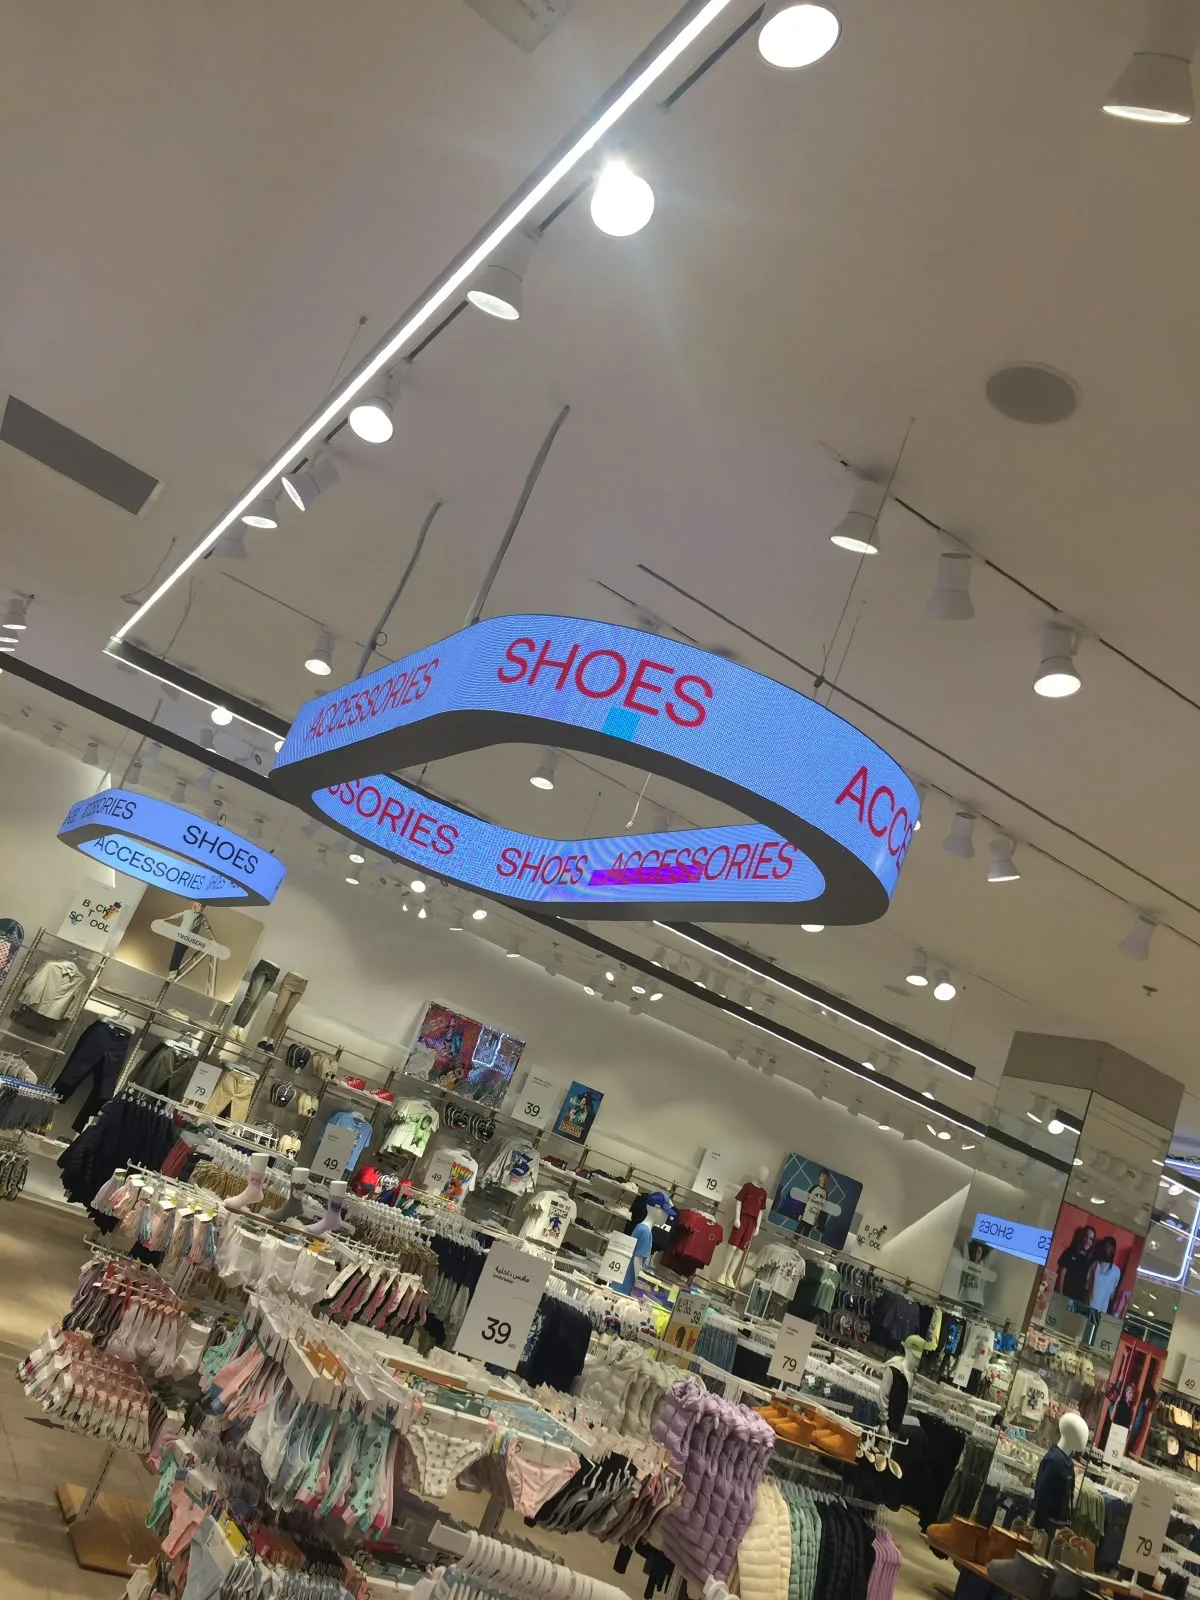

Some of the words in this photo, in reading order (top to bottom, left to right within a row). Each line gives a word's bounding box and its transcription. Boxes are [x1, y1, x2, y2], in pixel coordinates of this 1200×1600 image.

[305, 658, 440, 740] ACCESSORIES
[497, 637, 714, 728] SHOES
[183, 825, 258, 874] SHOES
[93, 837, 204, 890] ACCESSORIES
[496, 847, 588, 886] SHOES
[600, 841, 799, 885] ACCESSORIES
[69, 910, 110, 932] SCOOL
[176, 932, 206, 948] TROUSERS
[195, 1085, 206, 1096] 79
[524, 1102, 541, 1117] 39
[323, 1157, 339, 1171] 49
[431, 1172, 442, 1181] 49
[706, 1178, 718, 1190] 19
[856, 1235, 880, 1250] SCOOL
[608, 1261, 621, 1272] 49
[481, 1316, 512, 1345] 39
[782, 1355, 798, 1372] 79
[1184, 1378, 1196, 1390] 49
[420, 1413, 432, 1427] 5
[514, 1441, 524, 1454] 5
[1136, 1535, 1153, 1557] 79
